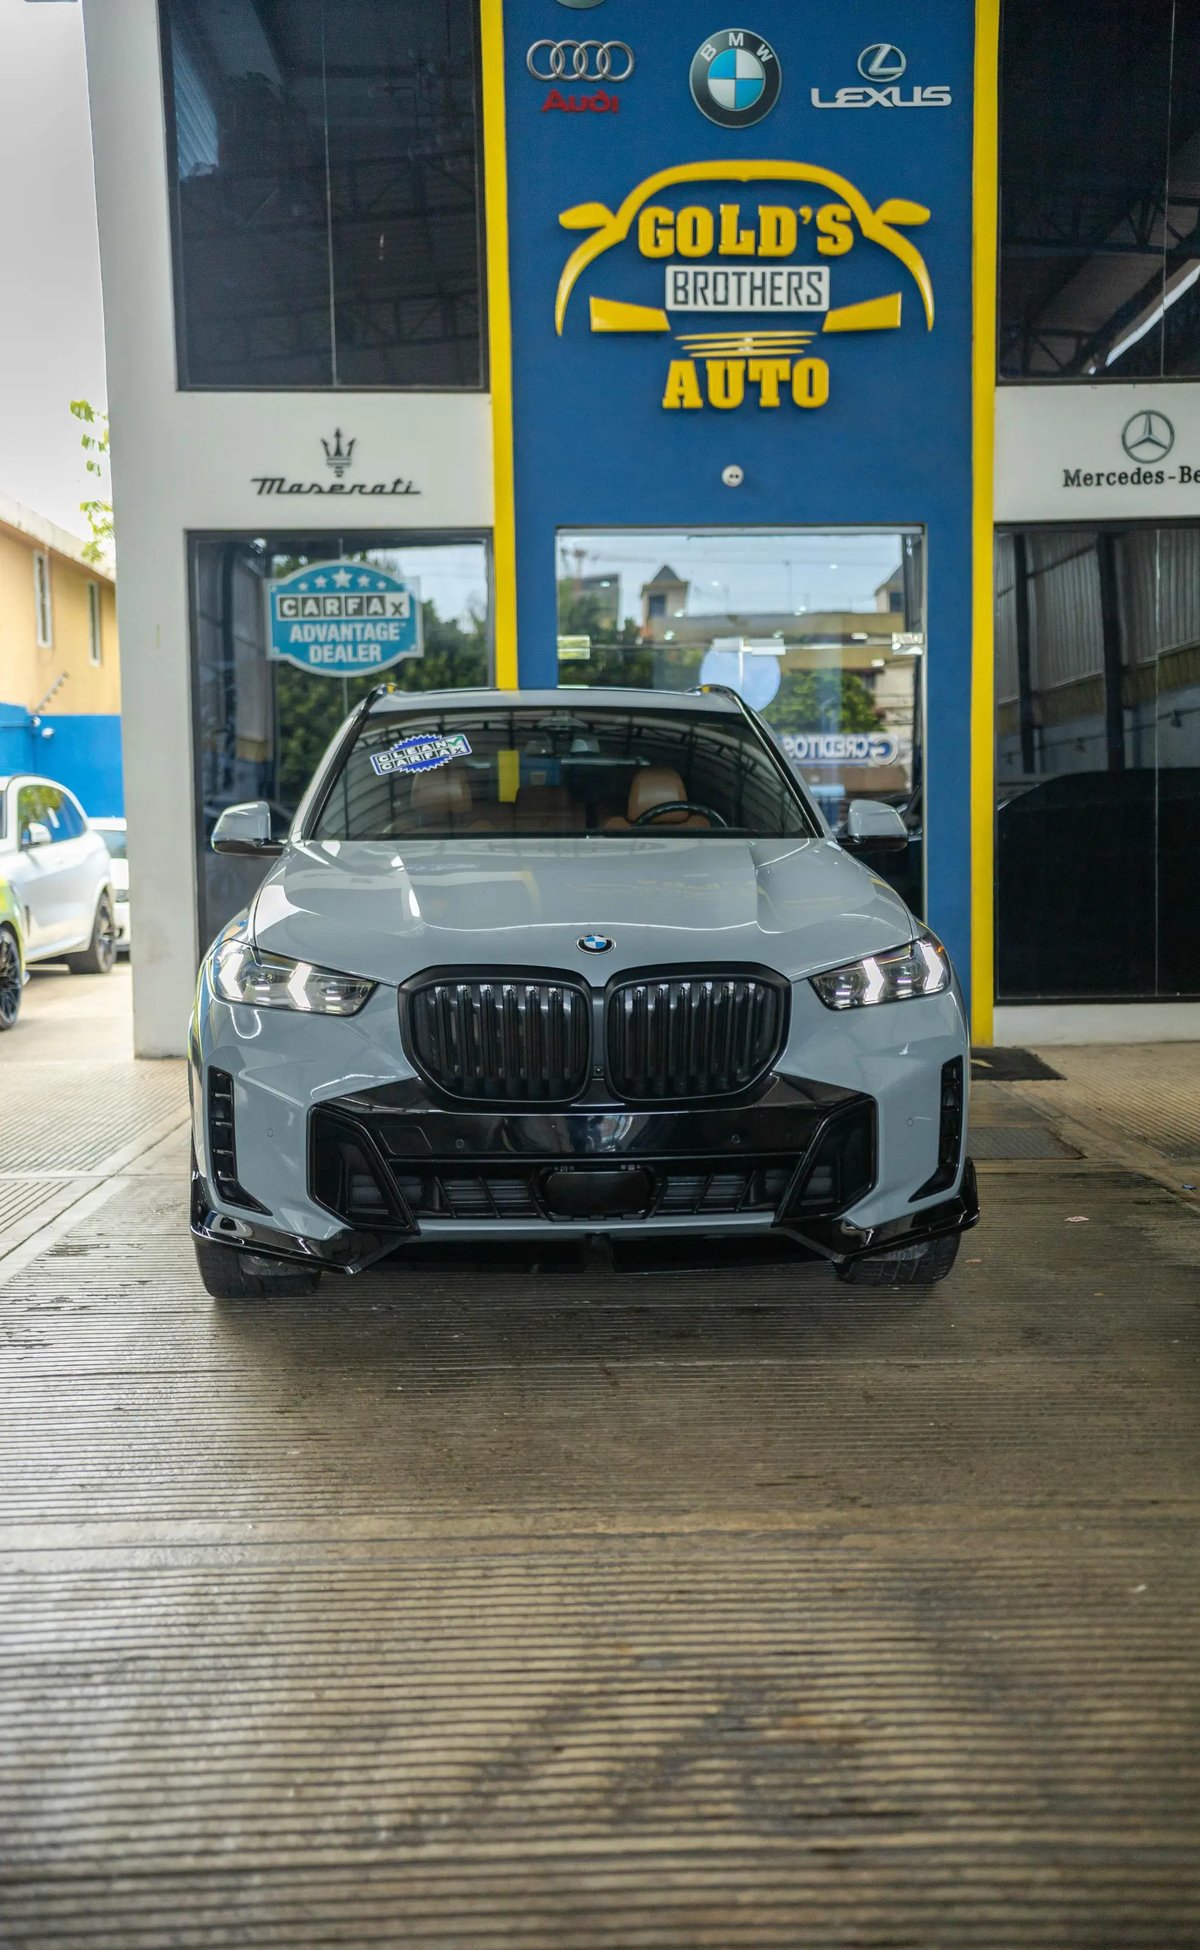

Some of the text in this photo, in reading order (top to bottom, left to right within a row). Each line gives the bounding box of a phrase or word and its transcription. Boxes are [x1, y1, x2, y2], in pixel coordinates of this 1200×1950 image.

[700, 32, 774, 62] BMW
[541, 88, 619, 113] Audi
[811, 86, 952, 108] LEXUS
[638, 203, 854, 259] GOLD'S
[673, 271, 823, 306] BROTHERS
[662, 357, 829, 409] AUTO
[251, 478, 421, 495] Maserati
[281, 598, 404, 616] CARFAX
[308, 643, 383, 664] DEALER
[378, 740, 447, 762] CLEAN
[381, 747, 464, 771] CARFAX
